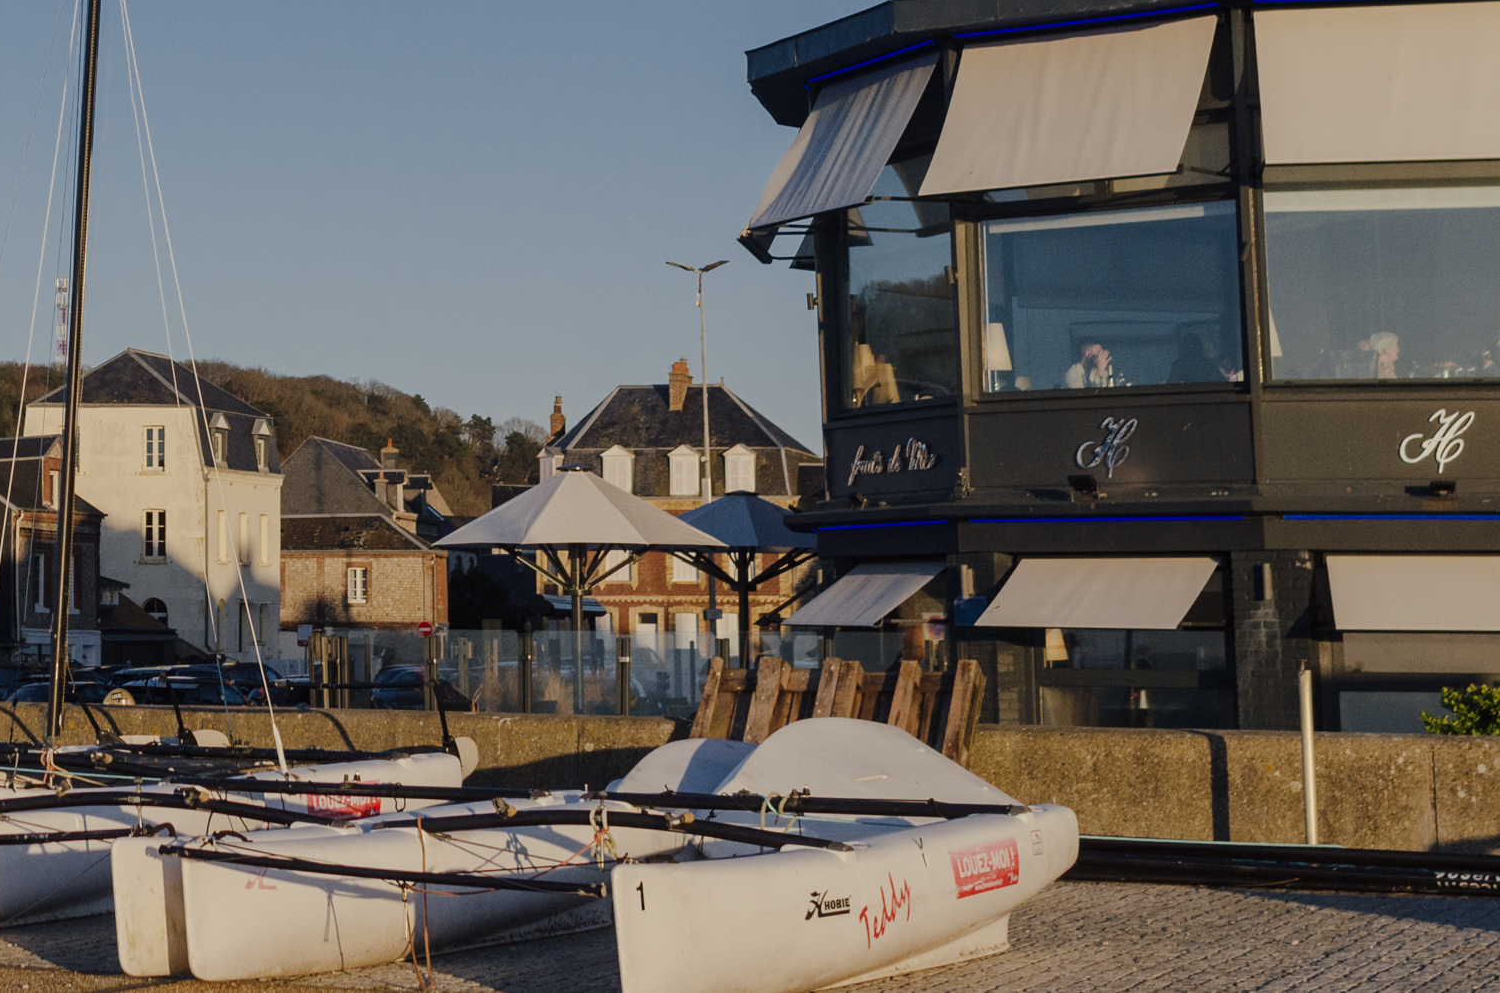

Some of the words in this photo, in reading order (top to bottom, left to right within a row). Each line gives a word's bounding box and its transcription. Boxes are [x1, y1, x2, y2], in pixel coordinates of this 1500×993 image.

[636, 881, 646, 912] 1
[824, 898, 850, 911] HOBIE
[858, 871, 911, 950] Teddy
